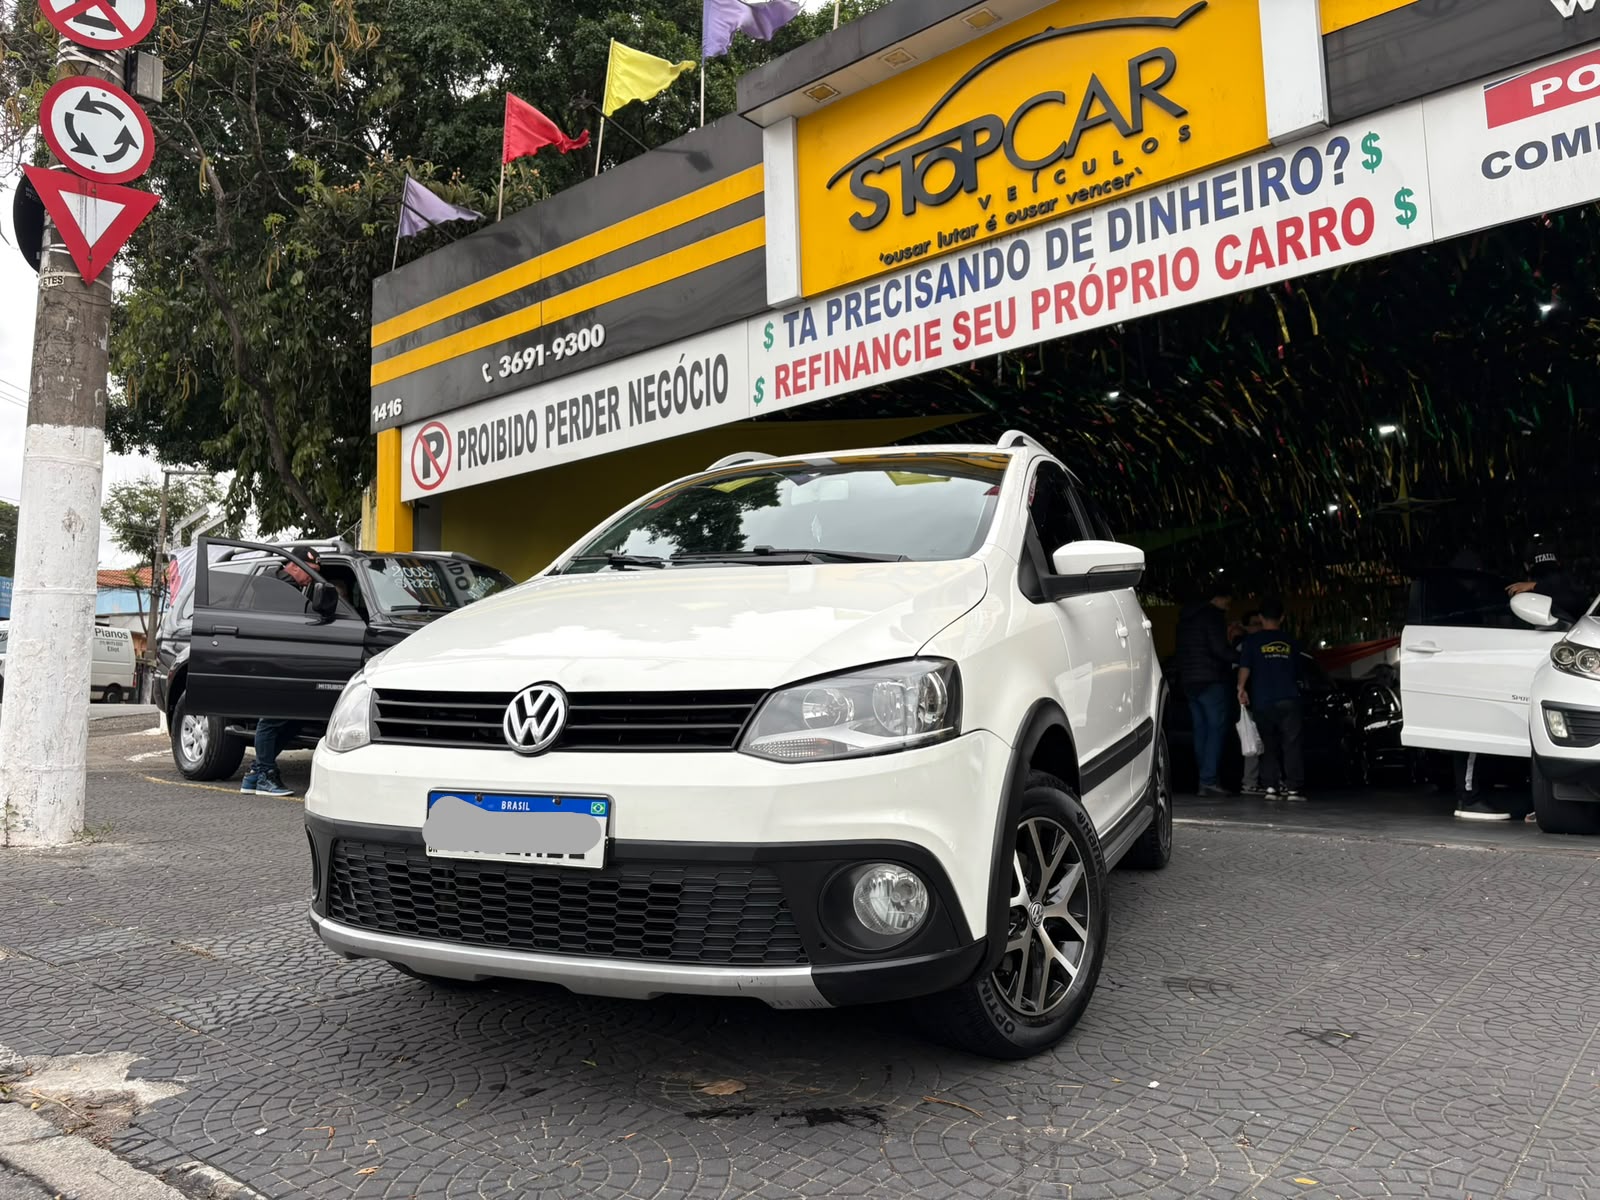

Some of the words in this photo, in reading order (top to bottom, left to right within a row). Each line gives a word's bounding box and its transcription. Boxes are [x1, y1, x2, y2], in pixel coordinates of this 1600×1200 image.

[848, 46, 1189, 232] STOPCAR
[978, 124, 1192, 211] VEÍCULOS
[1481, 122, 1600, 180] COM
[782, 310, 818, 347] TA
[826, 239, 1031, 336] PRECISANDO
[1045, 217, 1094, 270] DE
[1108, 136, 1351, 253] DINHEIRO?
[936, 222, 978, 248] lutar
[986, 214, 998, 232] é
[1005, 196, 1058, 226] ousar
[775, 319, 942, 400] REFINANCIE
[952, 299, 1017, 351] SEU
[1031, 246, 1199, 330] PRÓPRIO
[1214, 197, 1375, 280] CARRO
[499, 323, 605, 379] 3691-9300
[372, 398, 403, 422] 1416
[456, 409, 538, 471] PROIBIDO
[545, 386, 621, 449] PERDER
[628, 353, 729, 428] NEGÓCIO
[94, 627, 129, 639] Pianos
[501, 800, 531, 811] BRASIL
[978, 977, 1016, 1035] OPTIM
